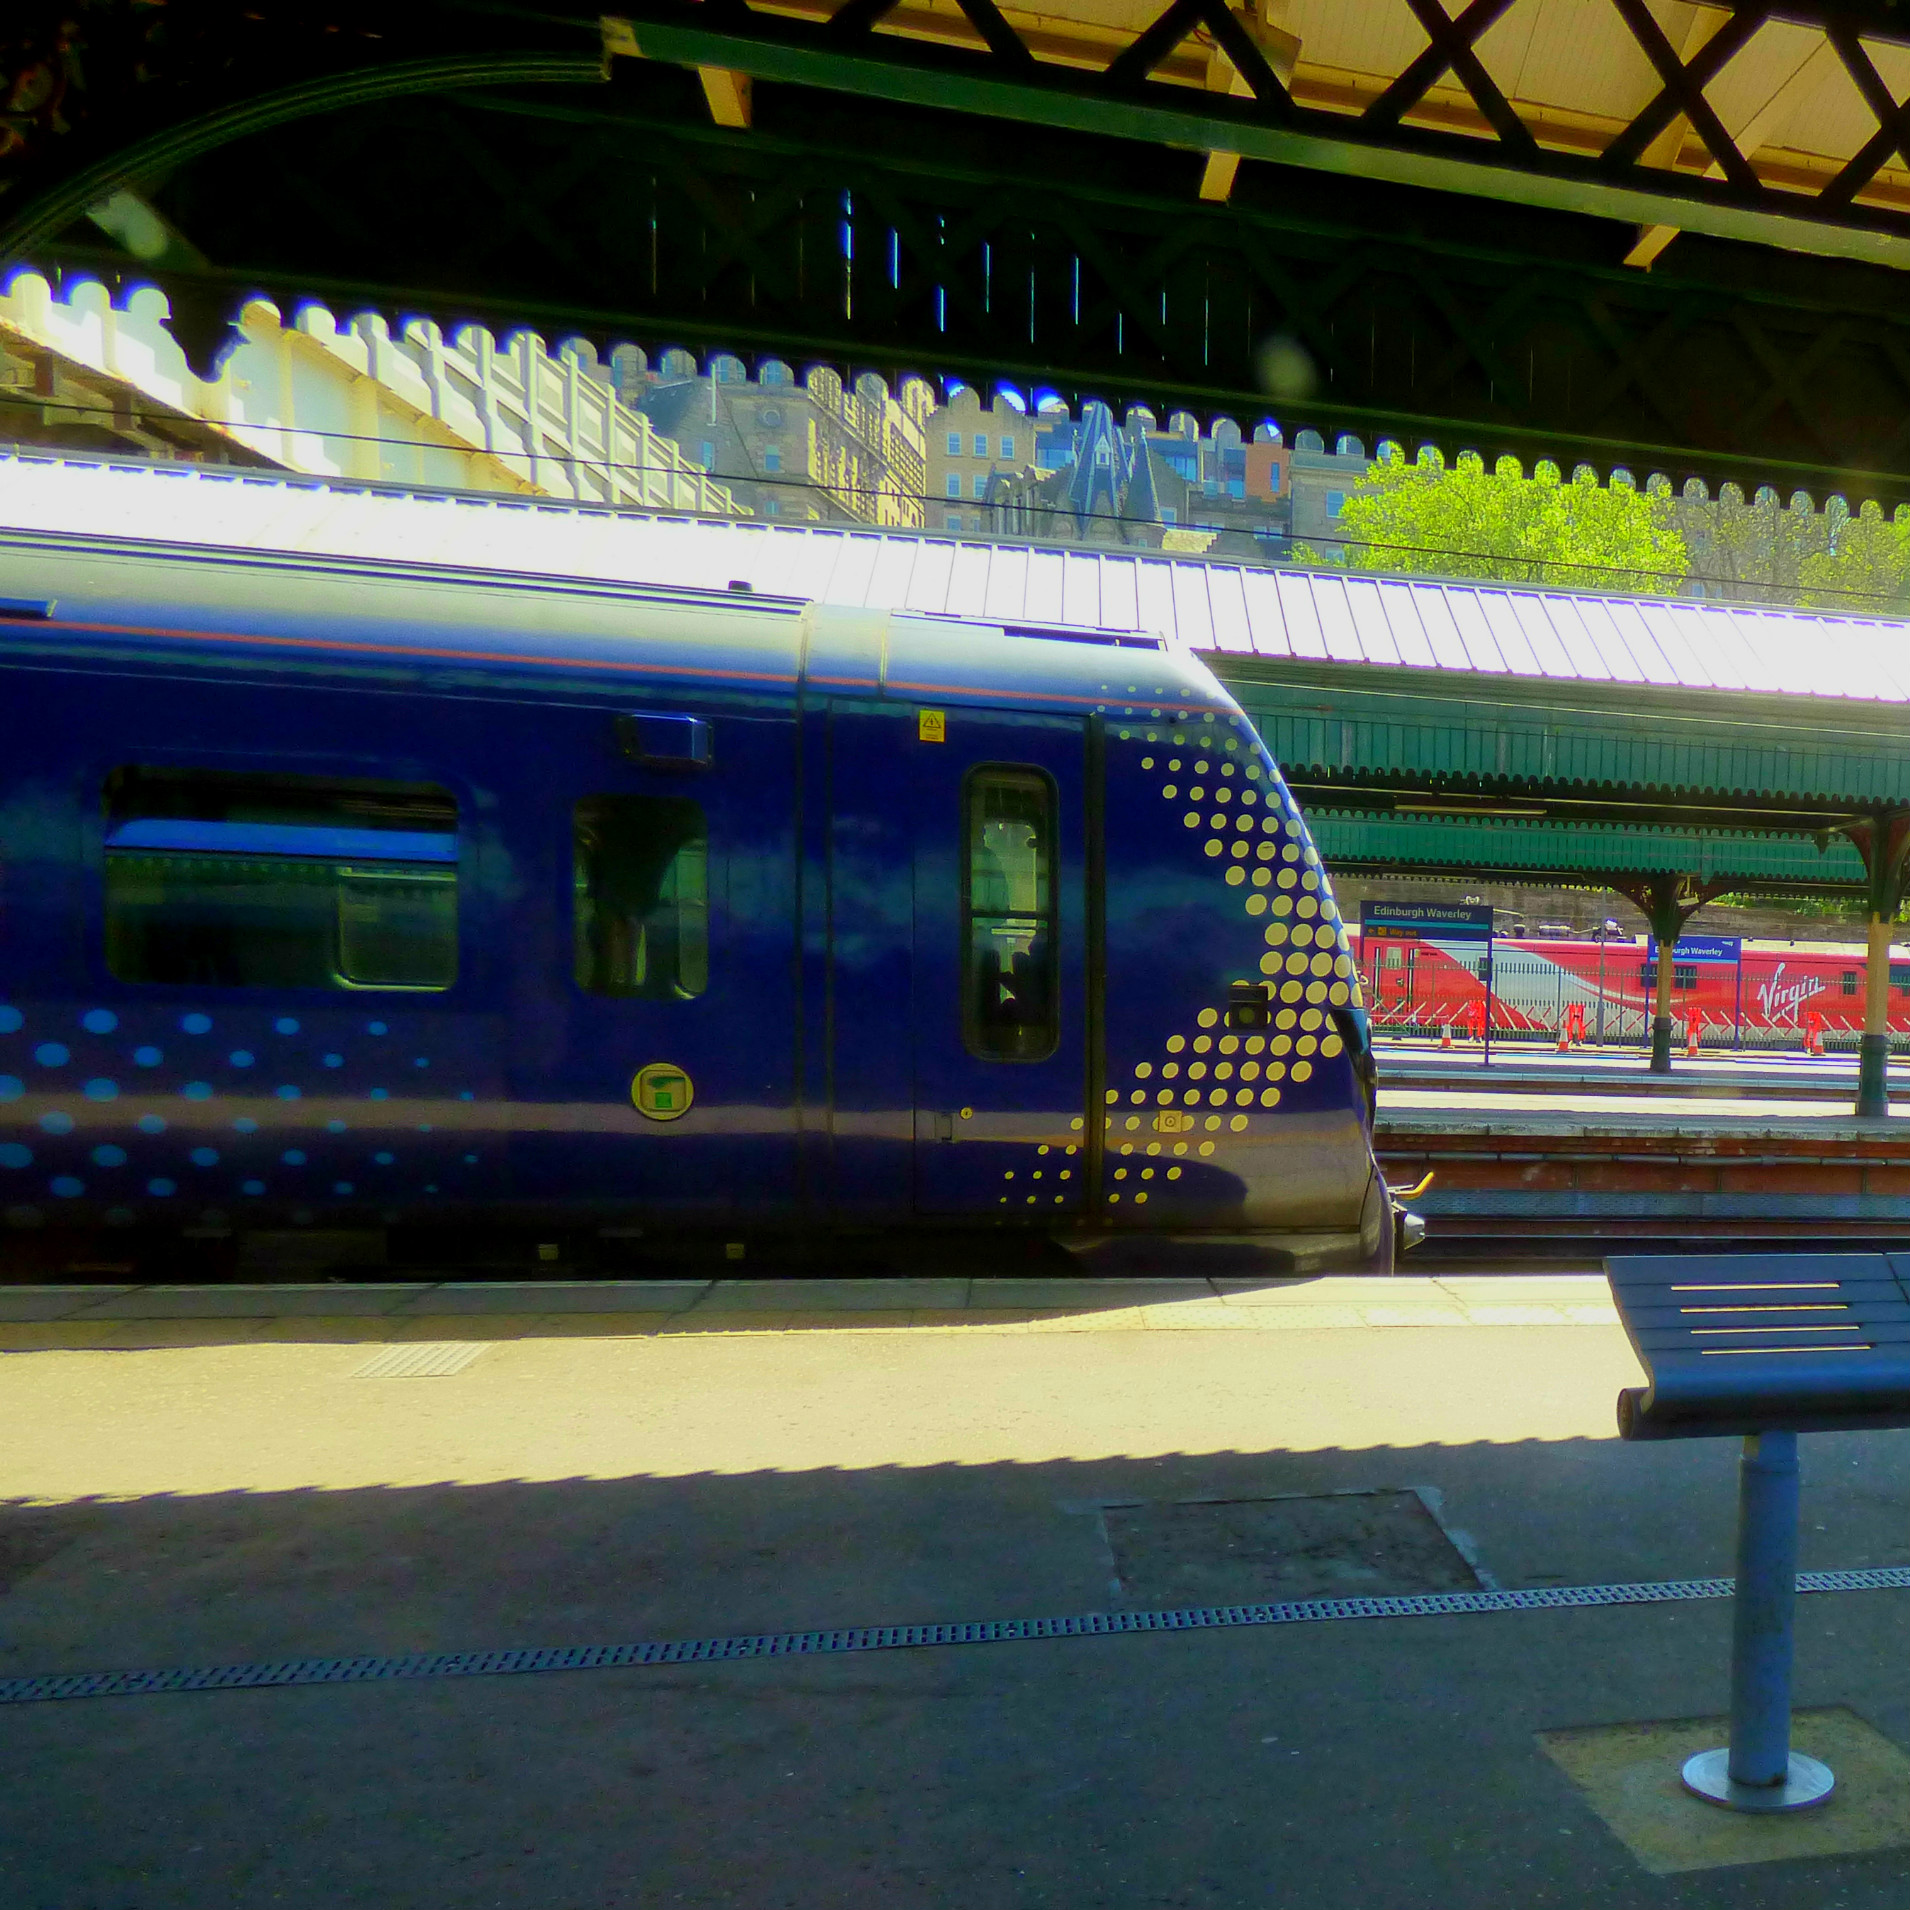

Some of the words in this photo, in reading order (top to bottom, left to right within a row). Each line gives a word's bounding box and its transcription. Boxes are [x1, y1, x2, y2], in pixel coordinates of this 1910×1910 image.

[1374, 905, 1424, 918] Edinburgh
[1427, 908, 1472, 920] Waverley
[1389, 927, 1403, 937] Way
[1655, 946, 1690, 956] Eurgh
[1691, 947, 1723, 957] Waverley
[1757, 962, 1826, 1025] Virgin
